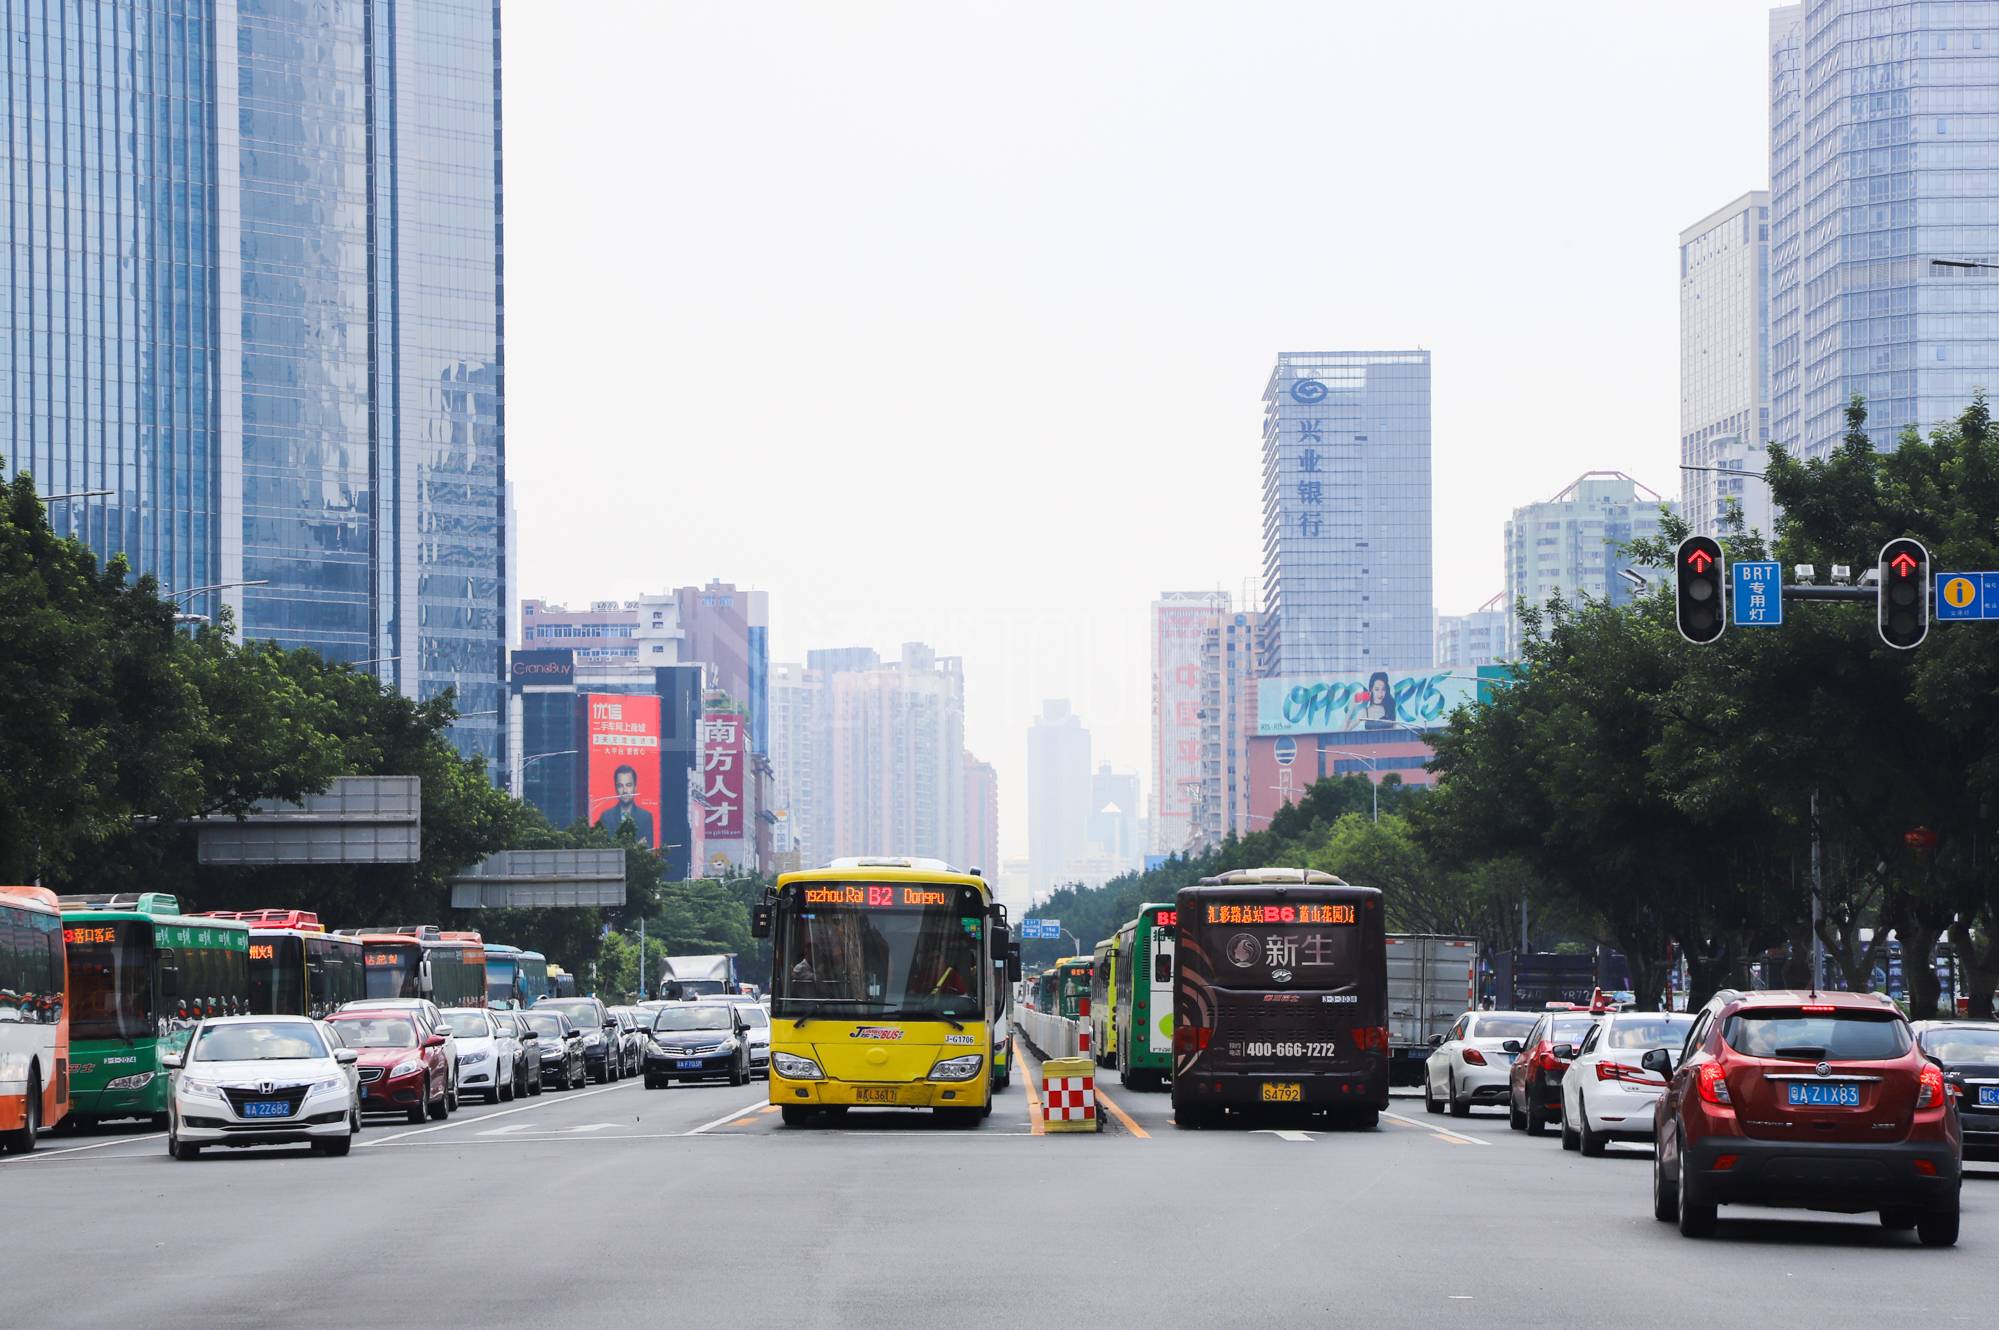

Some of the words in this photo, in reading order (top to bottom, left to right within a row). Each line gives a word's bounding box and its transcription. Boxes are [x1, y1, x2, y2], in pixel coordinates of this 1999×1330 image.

[1298, 420, 1323, 537] 兴业银行
[1743, 566, 1772, 581] BRT
[1749, 582, 1767, 621] 专用灯
[513, 661, 571, 675] GrandBuy
[1283, 681, 1370, 727] OPPO
[1394, 670, 1453, 722] R15
[592, 702, 622, 721] 优信
[593, 721, 646, 733] 二手车网上商城
[704, 718, 738, 827] 南方人才
[868, 886, 893, 906] B2
[1207, 904, 1264, 924] 汇彩路总站
[1264, 905, 1296, 923] B6
[1265, 933, 1335, 967] 新生
[945, 1036, 974, 1044] J-G1706
[1247, 1042, 1335, 1057] 400-666-7272
[1265, 1089, 1299, 1101] S4792
